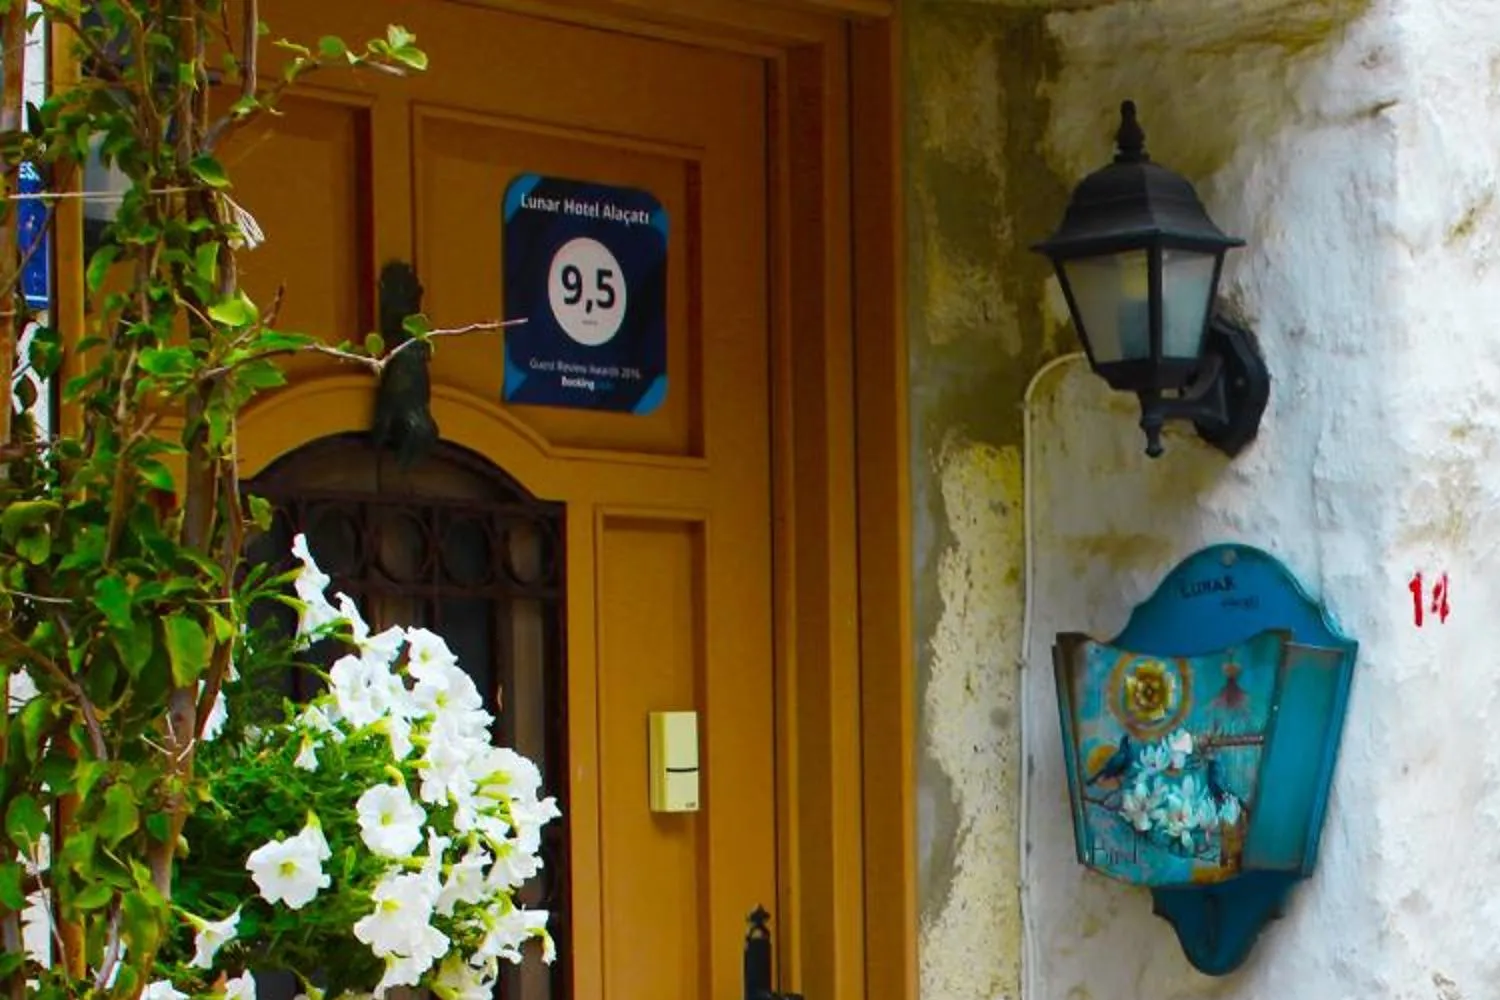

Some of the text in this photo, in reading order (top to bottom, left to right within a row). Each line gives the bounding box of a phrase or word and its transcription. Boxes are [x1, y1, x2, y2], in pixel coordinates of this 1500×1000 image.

[520, 192, 650, 227] Lunar Hotel Alaçatı
[561, 264, 615, 314] 9,5
[1408, 571, 1450, 627] 14
